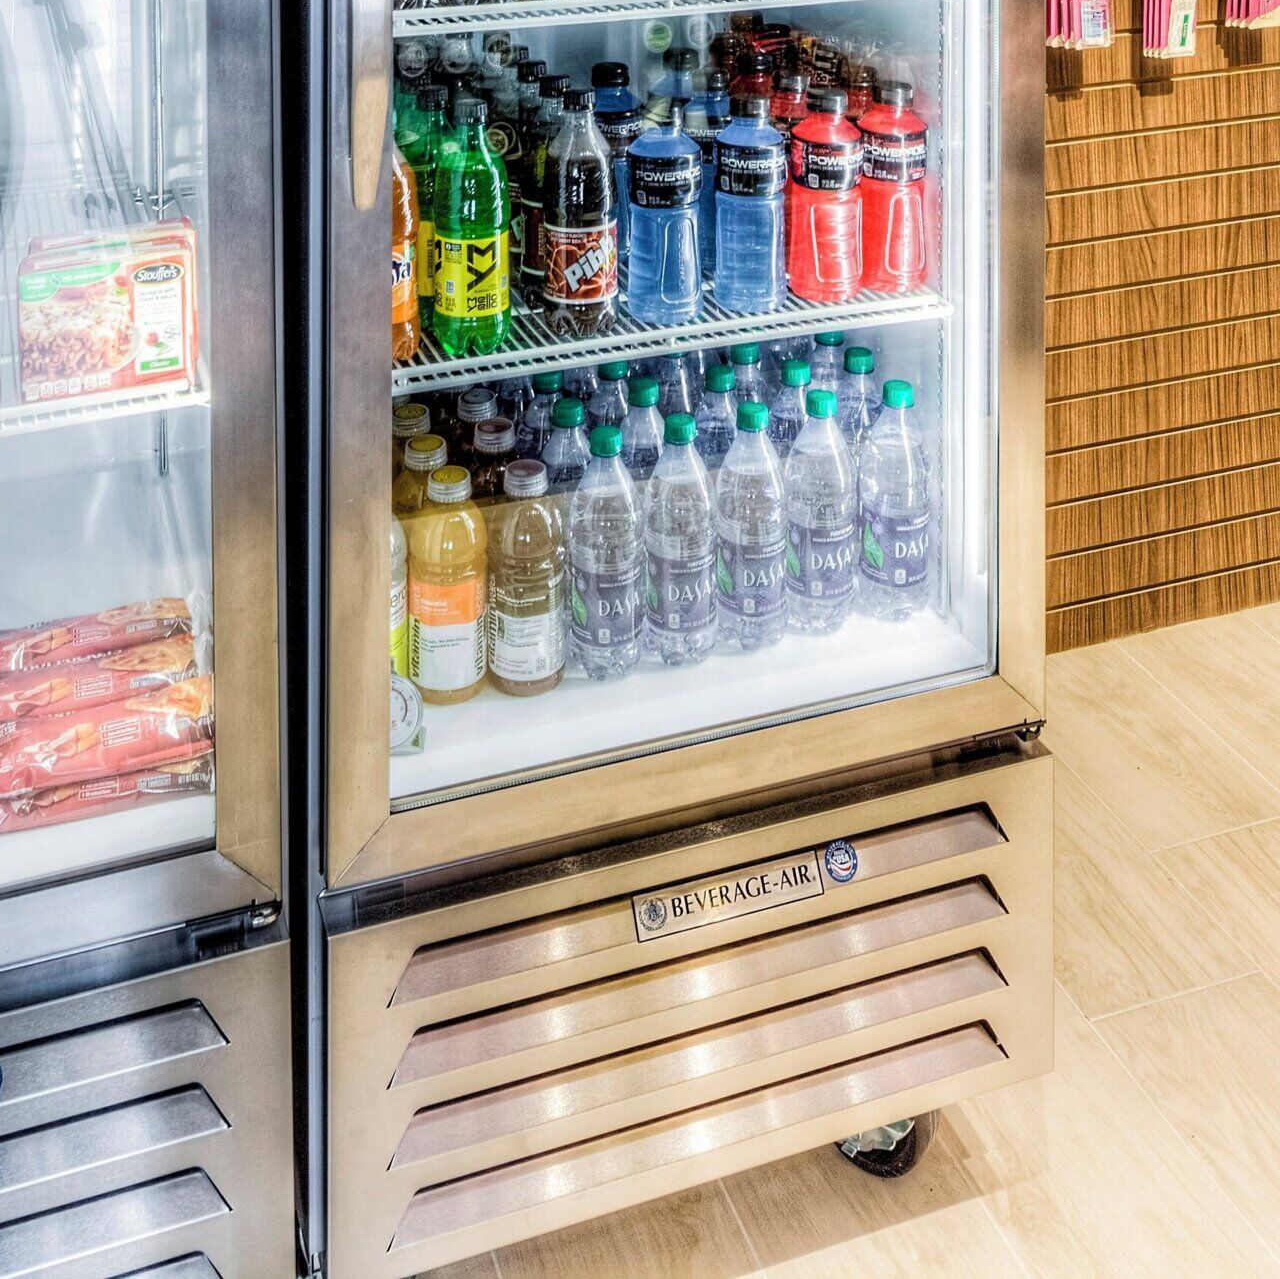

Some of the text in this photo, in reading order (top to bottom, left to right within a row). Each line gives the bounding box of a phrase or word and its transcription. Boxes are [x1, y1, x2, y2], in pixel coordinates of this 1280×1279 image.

[864, 143, 925, 157] POWERADE
[721, 156, 785, 169] POWERADE
[636, 167, 700, 181] POWERADE
[137, 265, 181, 282] Stouffer's
[671, 865, 810, 917] BEVERAGE-AIR
